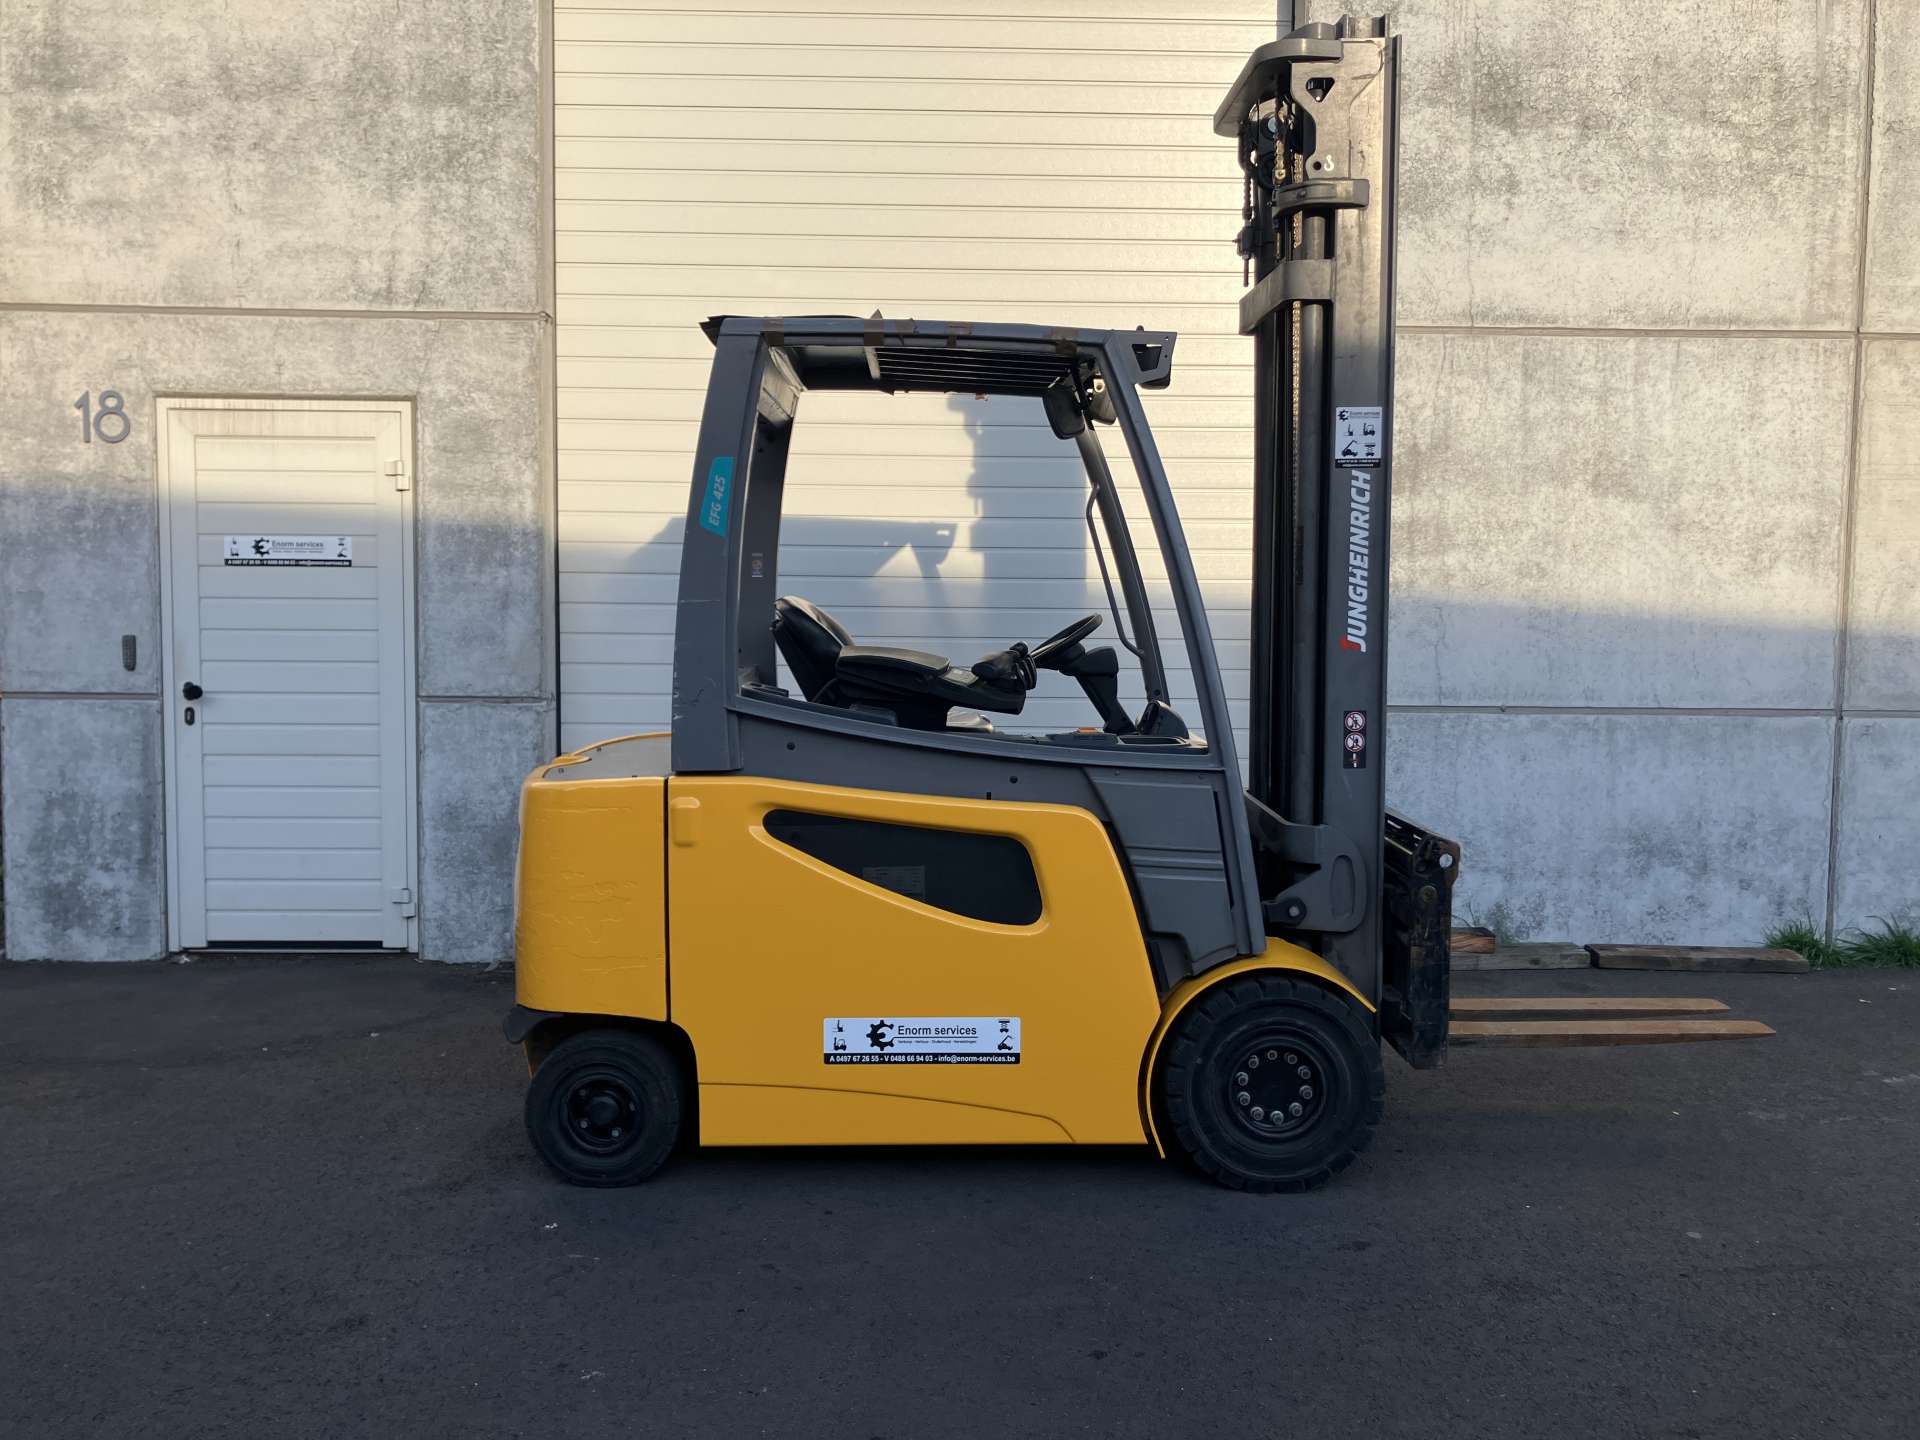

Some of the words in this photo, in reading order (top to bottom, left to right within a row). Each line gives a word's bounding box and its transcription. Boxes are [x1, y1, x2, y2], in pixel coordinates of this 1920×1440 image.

[73, 390, 131, 444] 18
[712, 474, 726, 501] 425
[708, 501, 722, 527] EFG
[1346, 469, 1371, 653] JUNGHEINRICH
[898, 1025, 931, 1035] Enorm
[934, 1025, 977, 1035] services
[938, 1055, 1015, 1063] info@enorm-services.be
